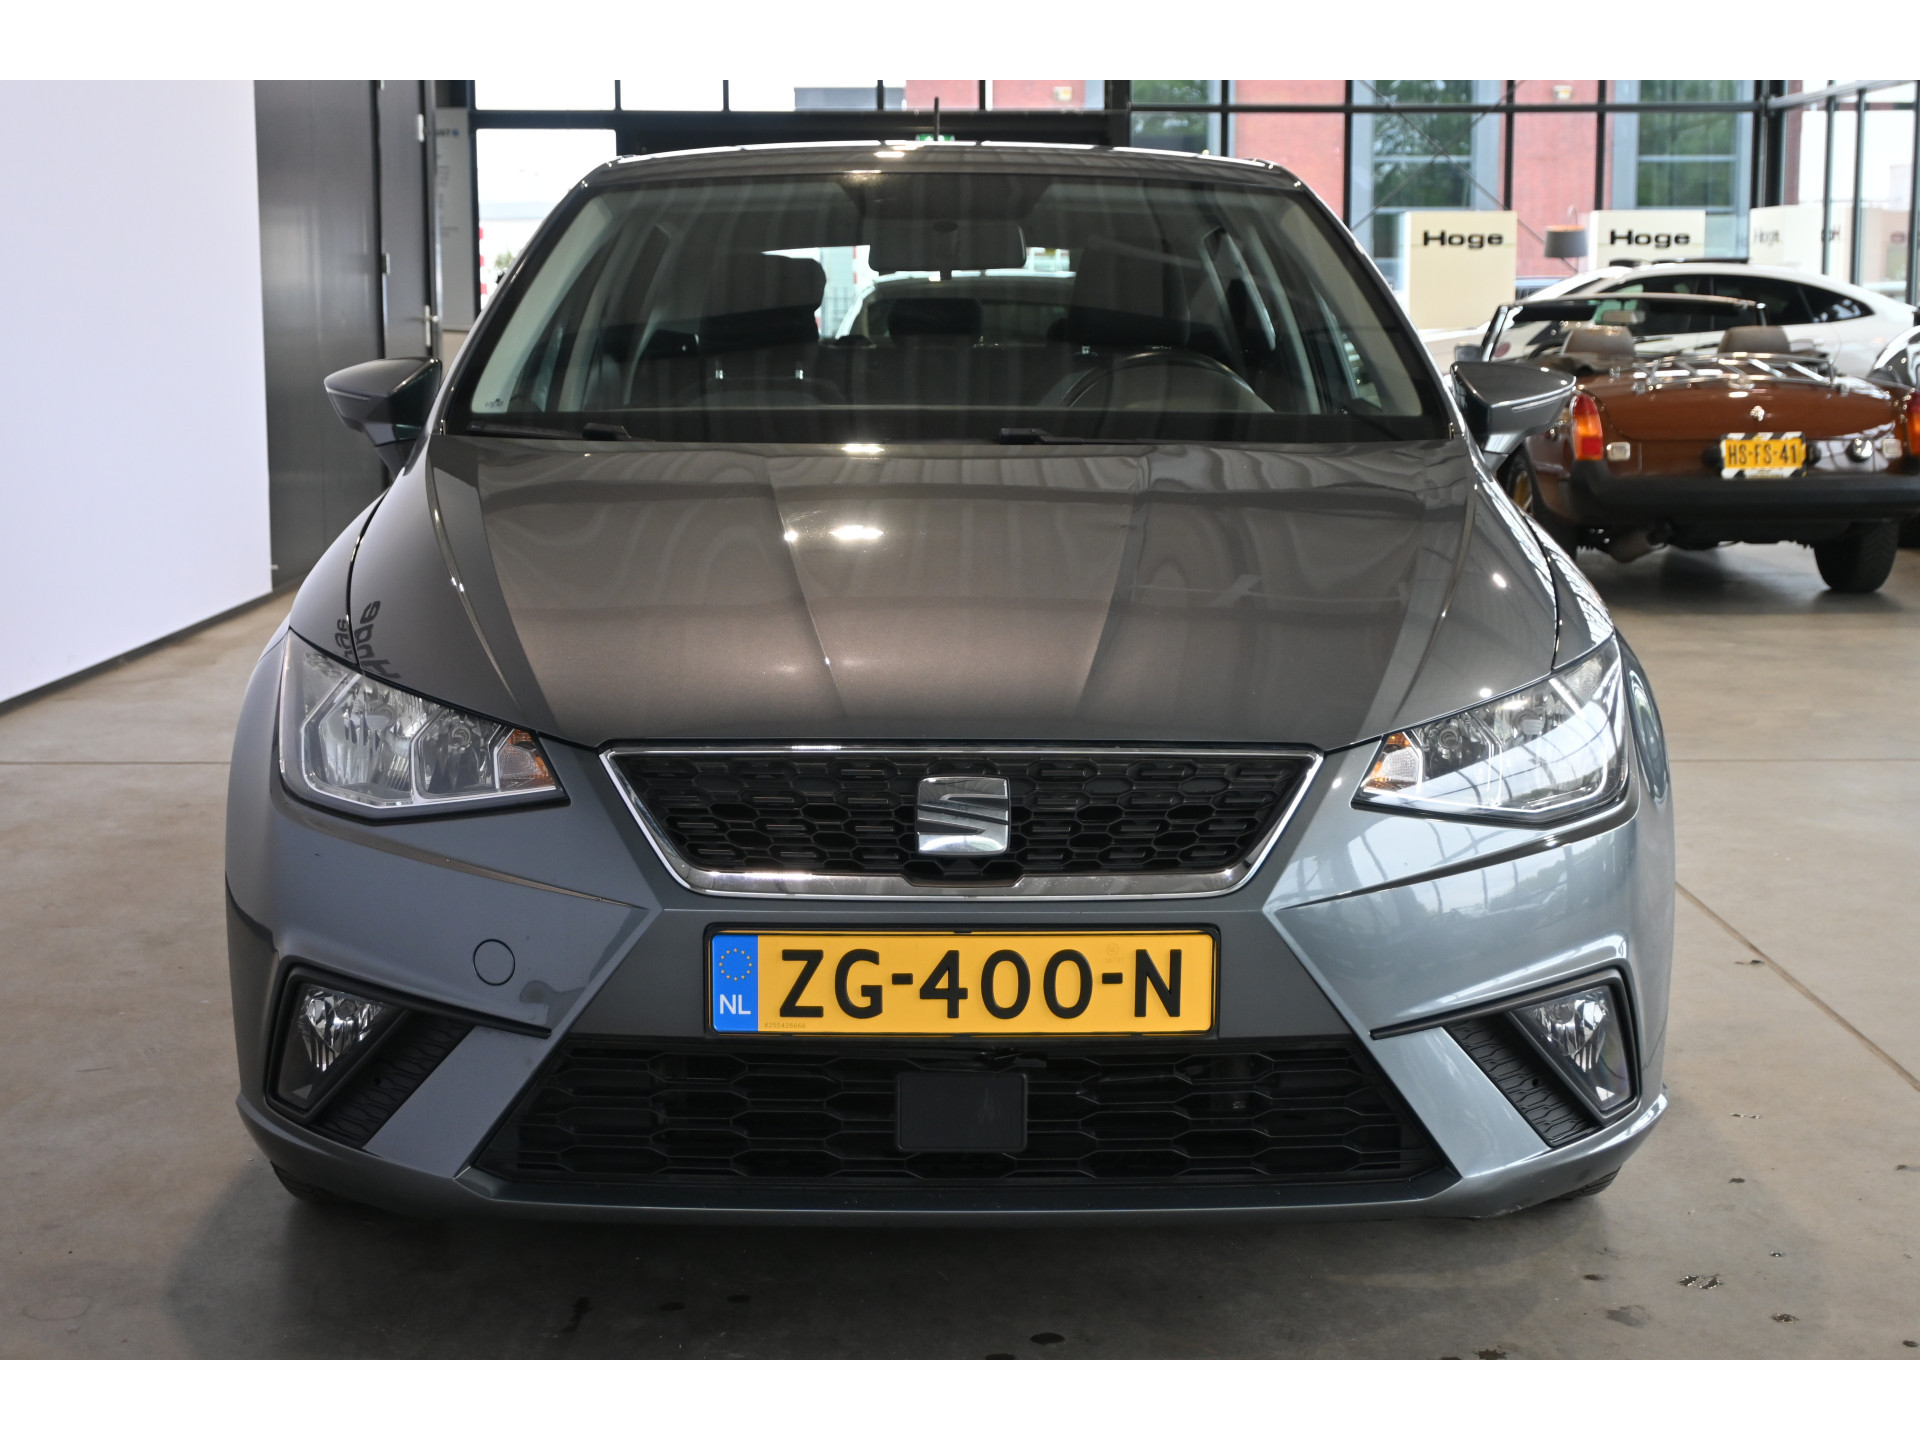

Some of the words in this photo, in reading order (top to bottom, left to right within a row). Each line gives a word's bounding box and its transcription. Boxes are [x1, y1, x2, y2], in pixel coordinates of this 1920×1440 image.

[1423, 230, 1504, 249] Hoge
[1609, 229, 1691, 249] Hoge
[1727, 443, 1797, 465] HS-FS-41
[778, 948, 1183, 1020] ZG-400-N
[719, 993, 752, 1016] NL
